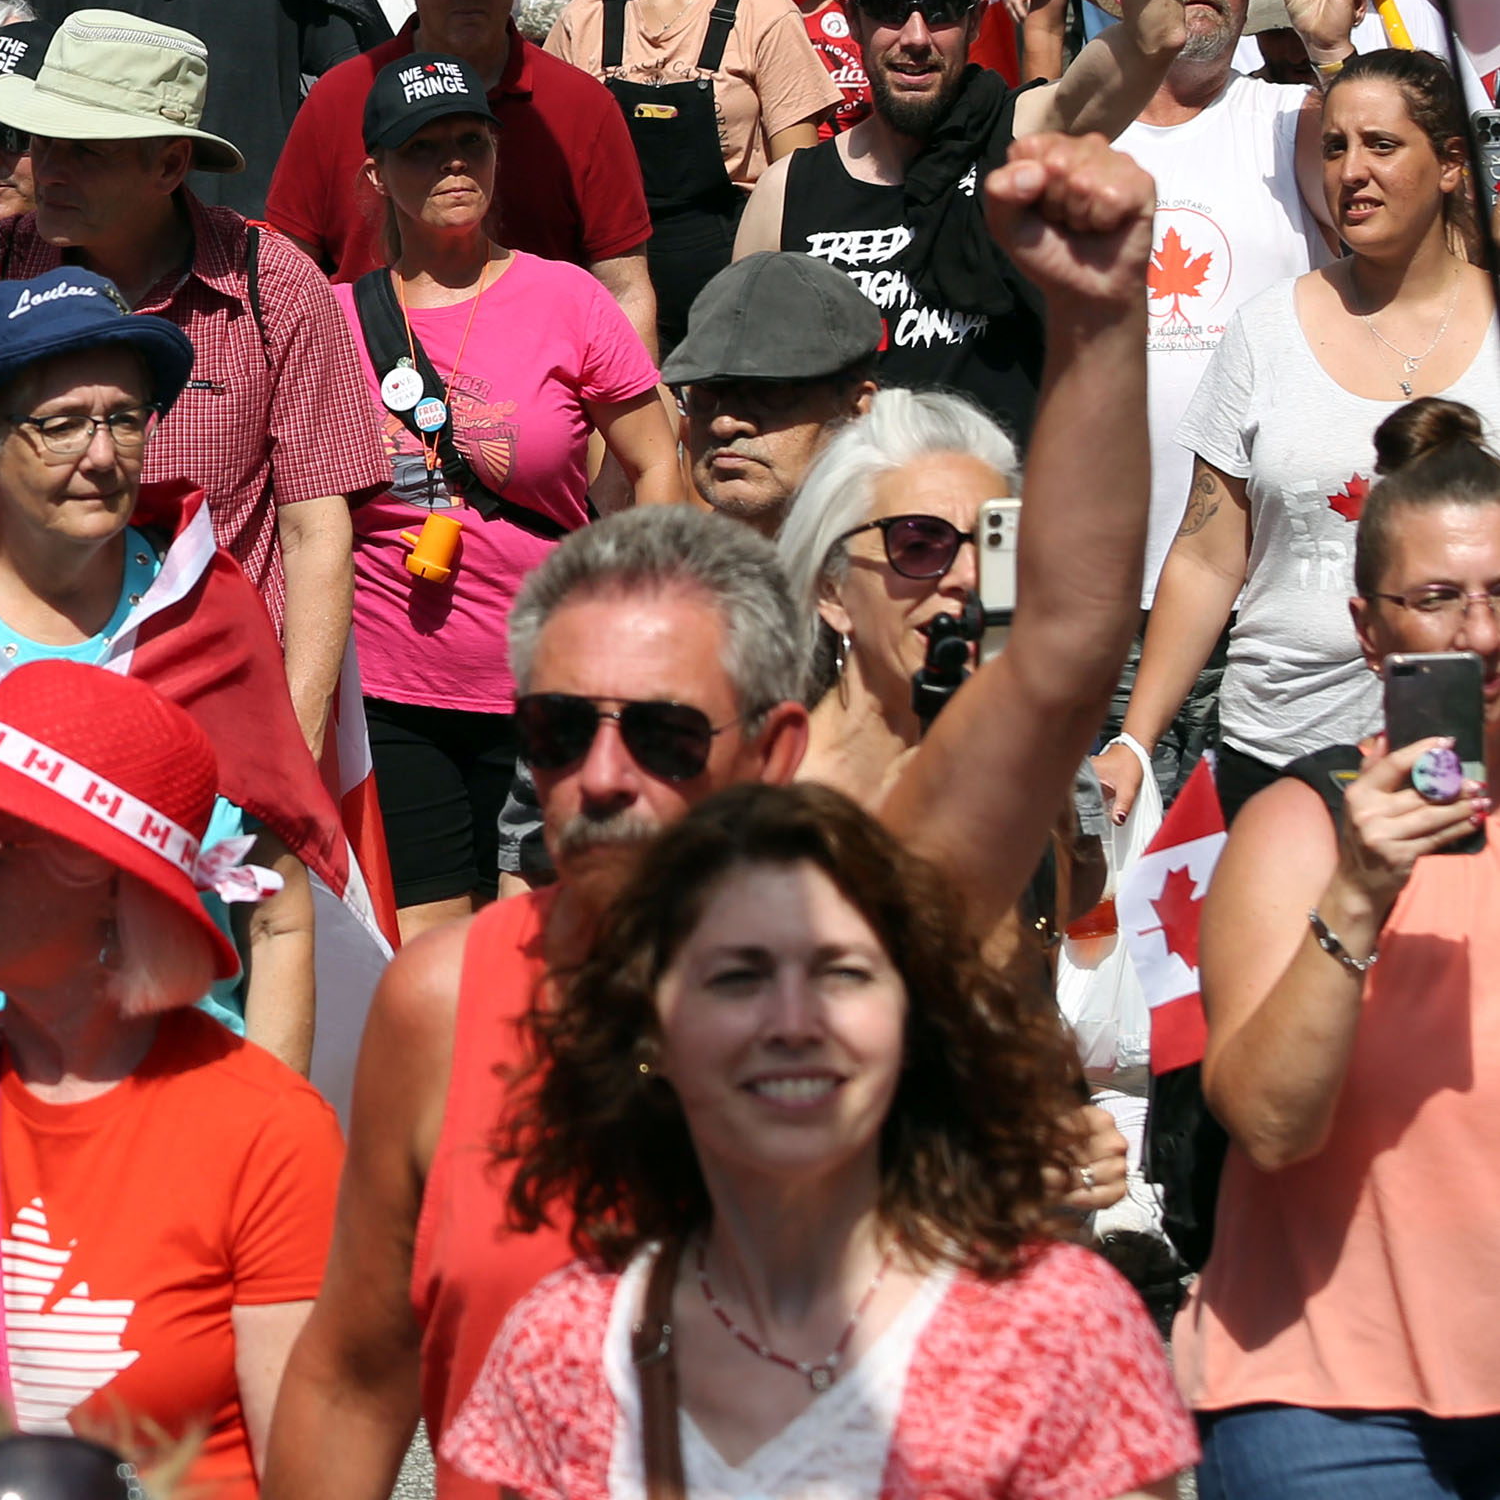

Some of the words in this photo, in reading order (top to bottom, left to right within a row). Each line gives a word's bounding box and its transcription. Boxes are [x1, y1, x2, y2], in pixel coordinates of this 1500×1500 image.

[398, 66, 425, 85] WE
[435, 62, 463, 78] THE
[403, 75, 470, 105] FRINGE
[1173, 199, 1212, 214] ONTARIO
[417, 403, 441, 417] FREE
[418, 413, 445, 428] HUGS
